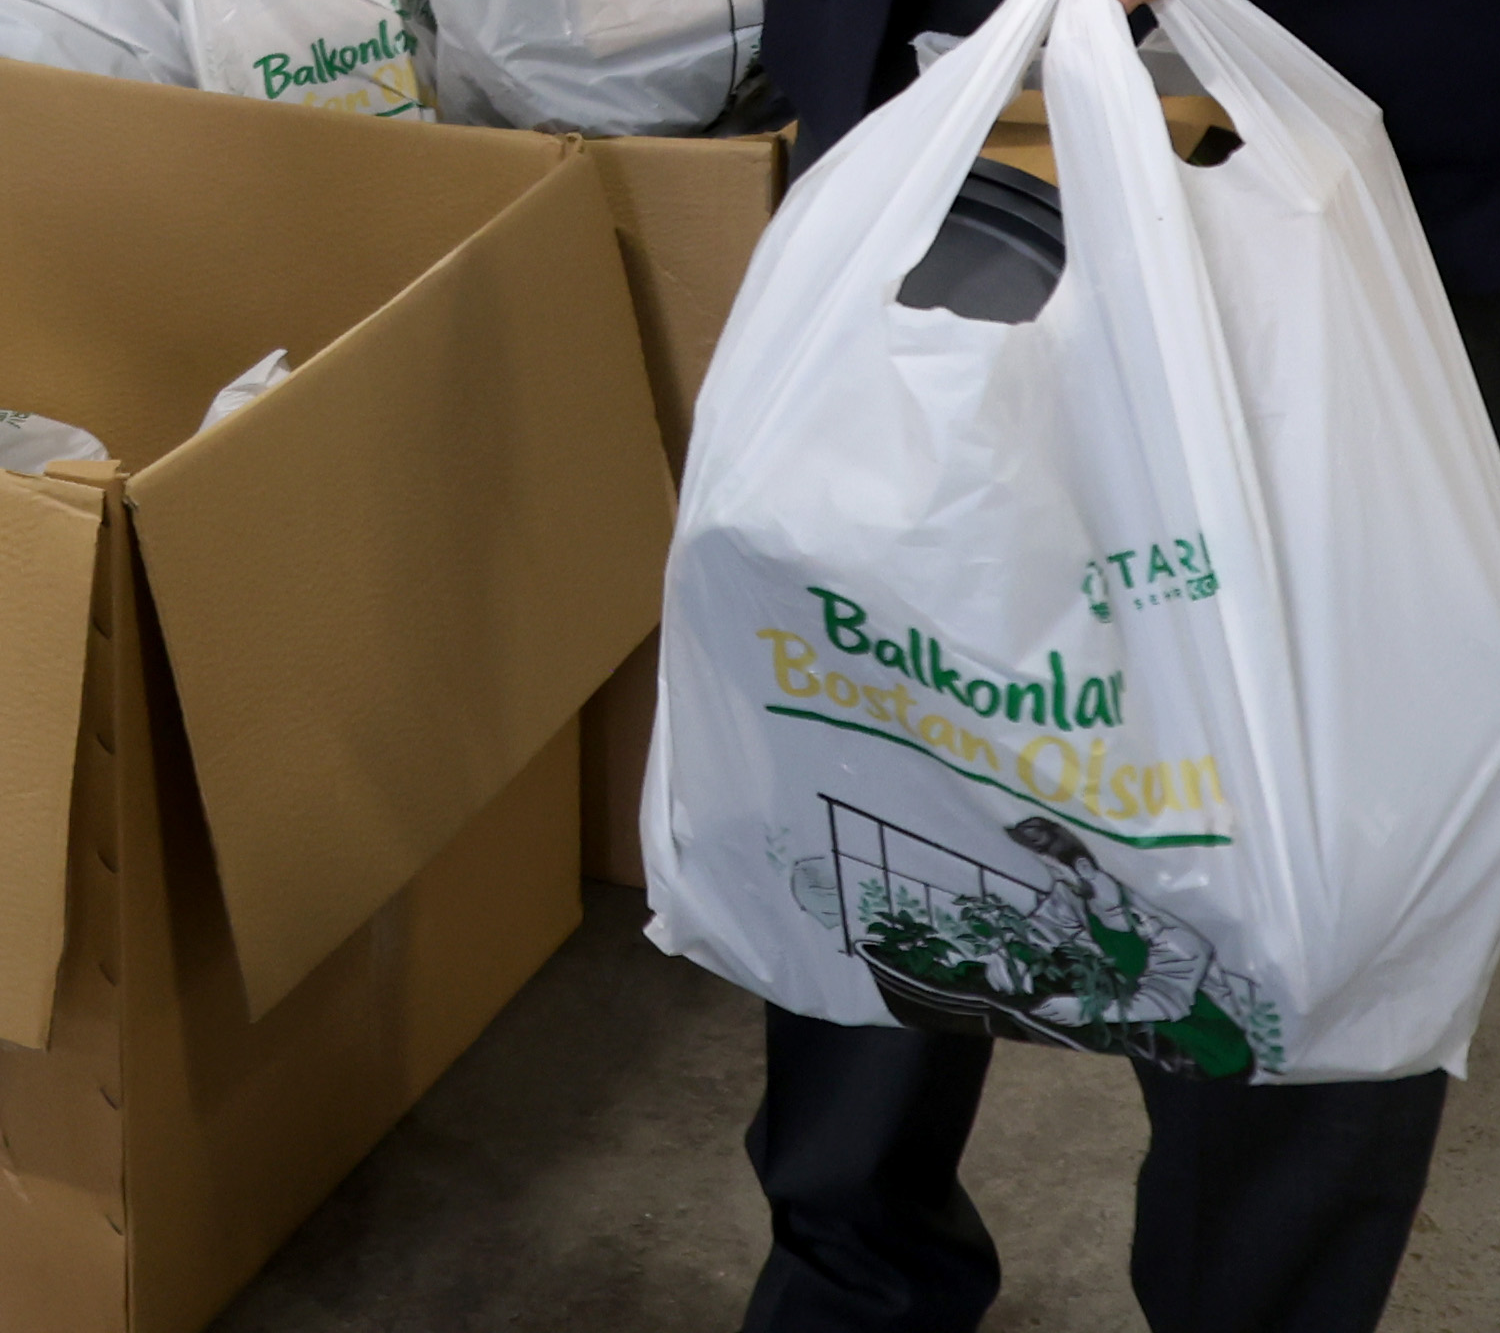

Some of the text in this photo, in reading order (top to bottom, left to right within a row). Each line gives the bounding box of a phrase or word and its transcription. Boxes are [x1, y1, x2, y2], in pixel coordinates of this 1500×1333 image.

[253, 19, 418, 100] Balkonla
[757, 627, 1226, 820] Bostan Olsun
